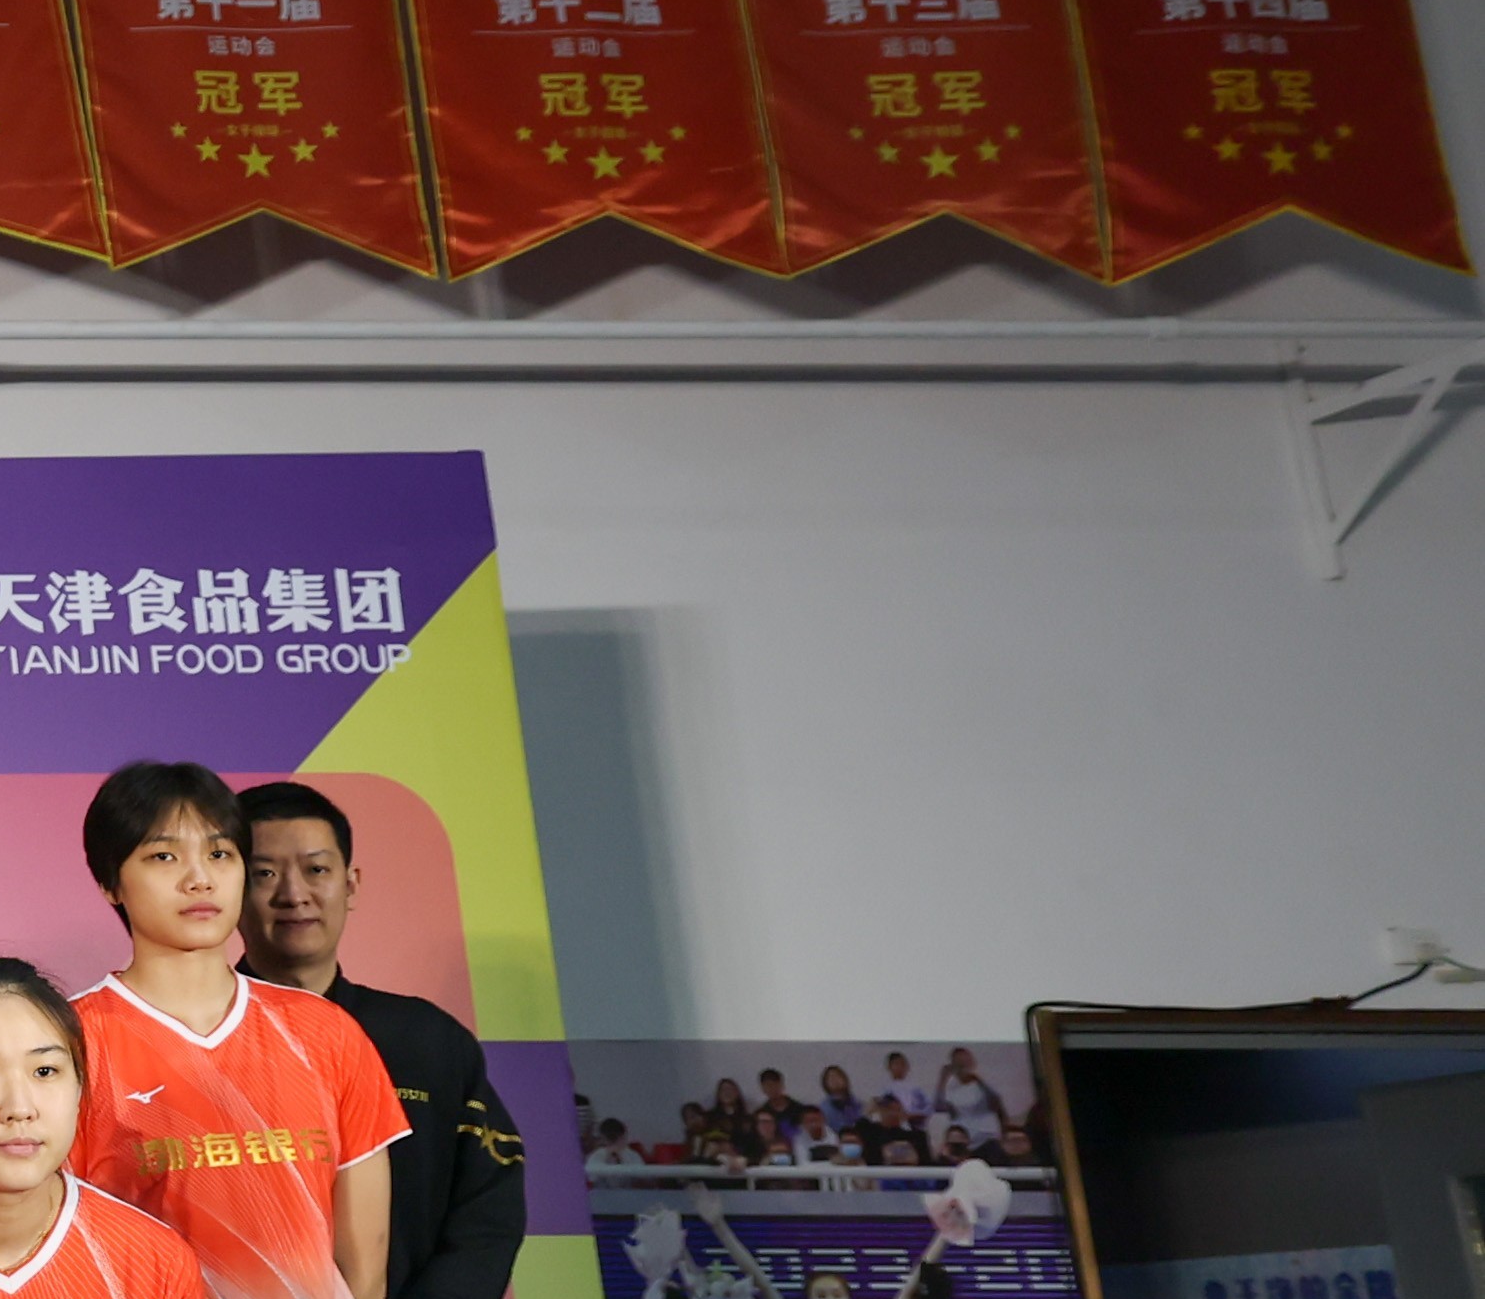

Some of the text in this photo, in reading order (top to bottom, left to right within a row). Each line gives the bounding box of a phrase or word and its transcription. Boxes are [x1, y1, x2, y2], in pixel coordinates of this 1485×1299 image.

[207, 35, 276, 56] 运动会
[195, 70, 303, 116] 冠军
[538, 73, 649, 118] 冠军
[866, 70, 987, 117] 冠军
[1209, 68, 1317, 116] 冠军
[151, 644, 264, 675] FOOD
[276, 643, 412, 674] GROUP
[134, 1128, 334, 1176] 渤海银行
